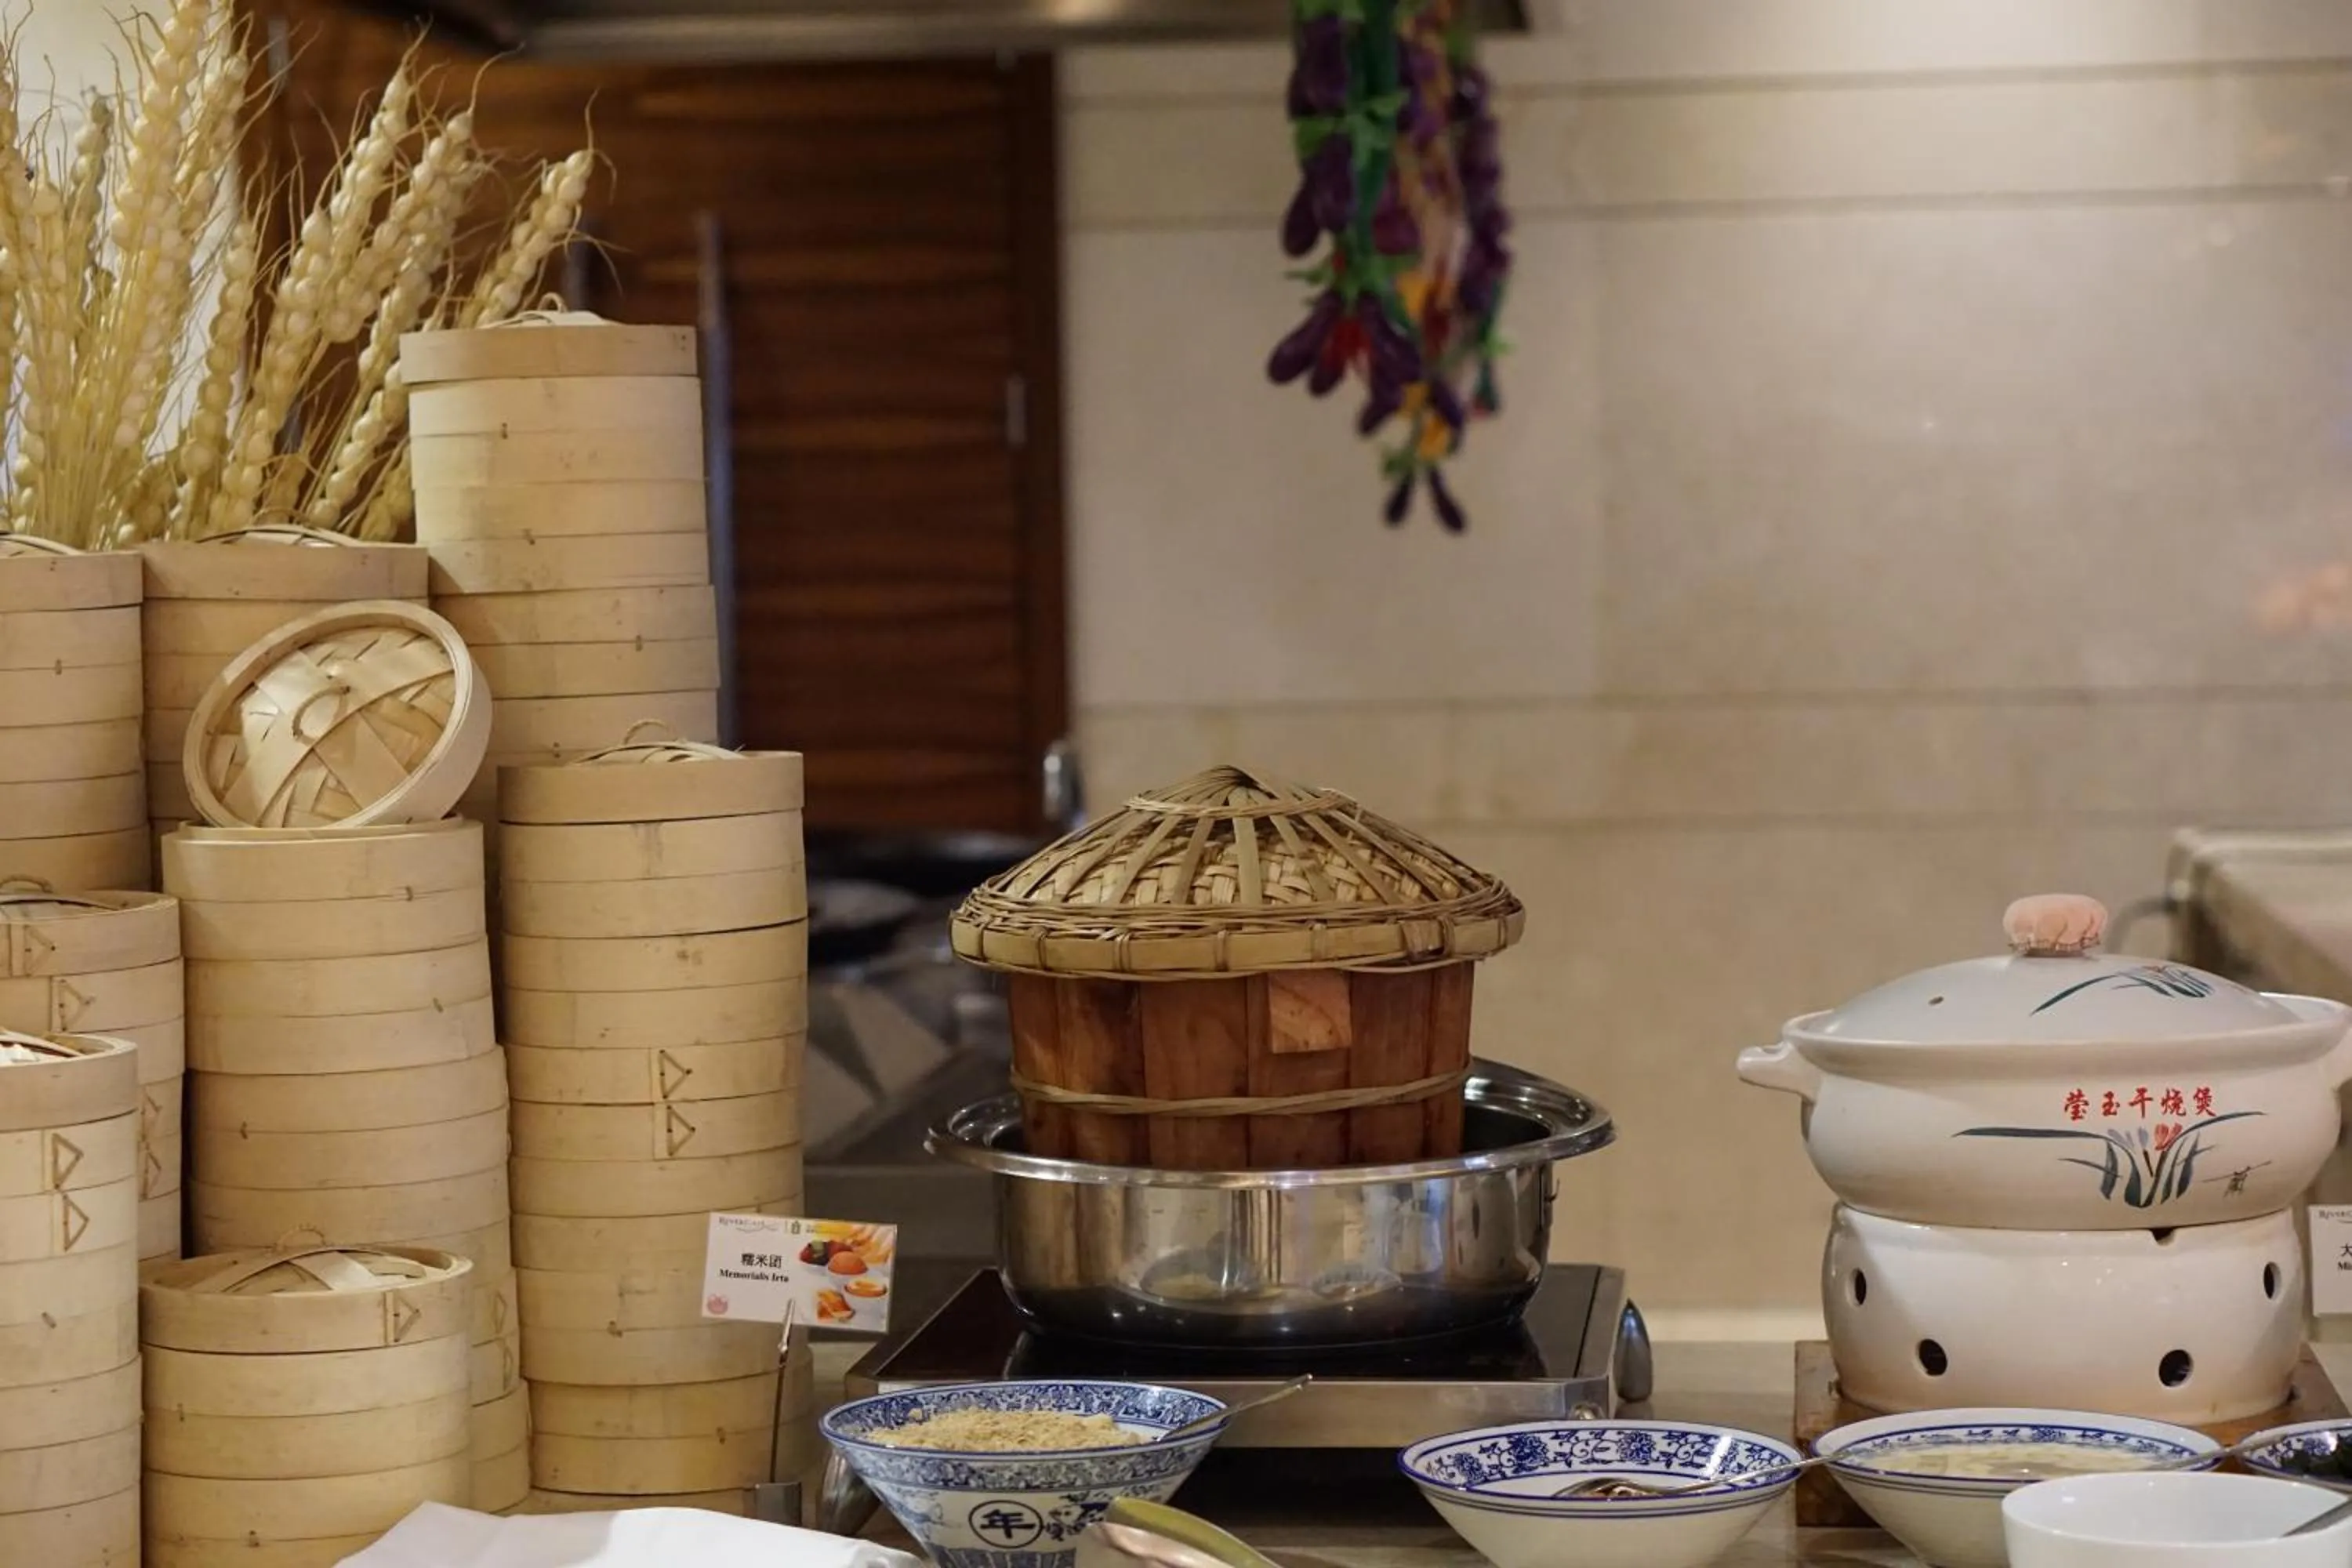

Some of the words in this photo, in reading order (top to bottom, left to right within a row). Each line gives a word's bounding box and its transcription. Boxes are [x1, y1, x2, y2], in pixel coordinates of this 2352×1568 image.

[741, 1253, 782, 1269] 糯米团
[980, 1508, 1036, 1539] 年
